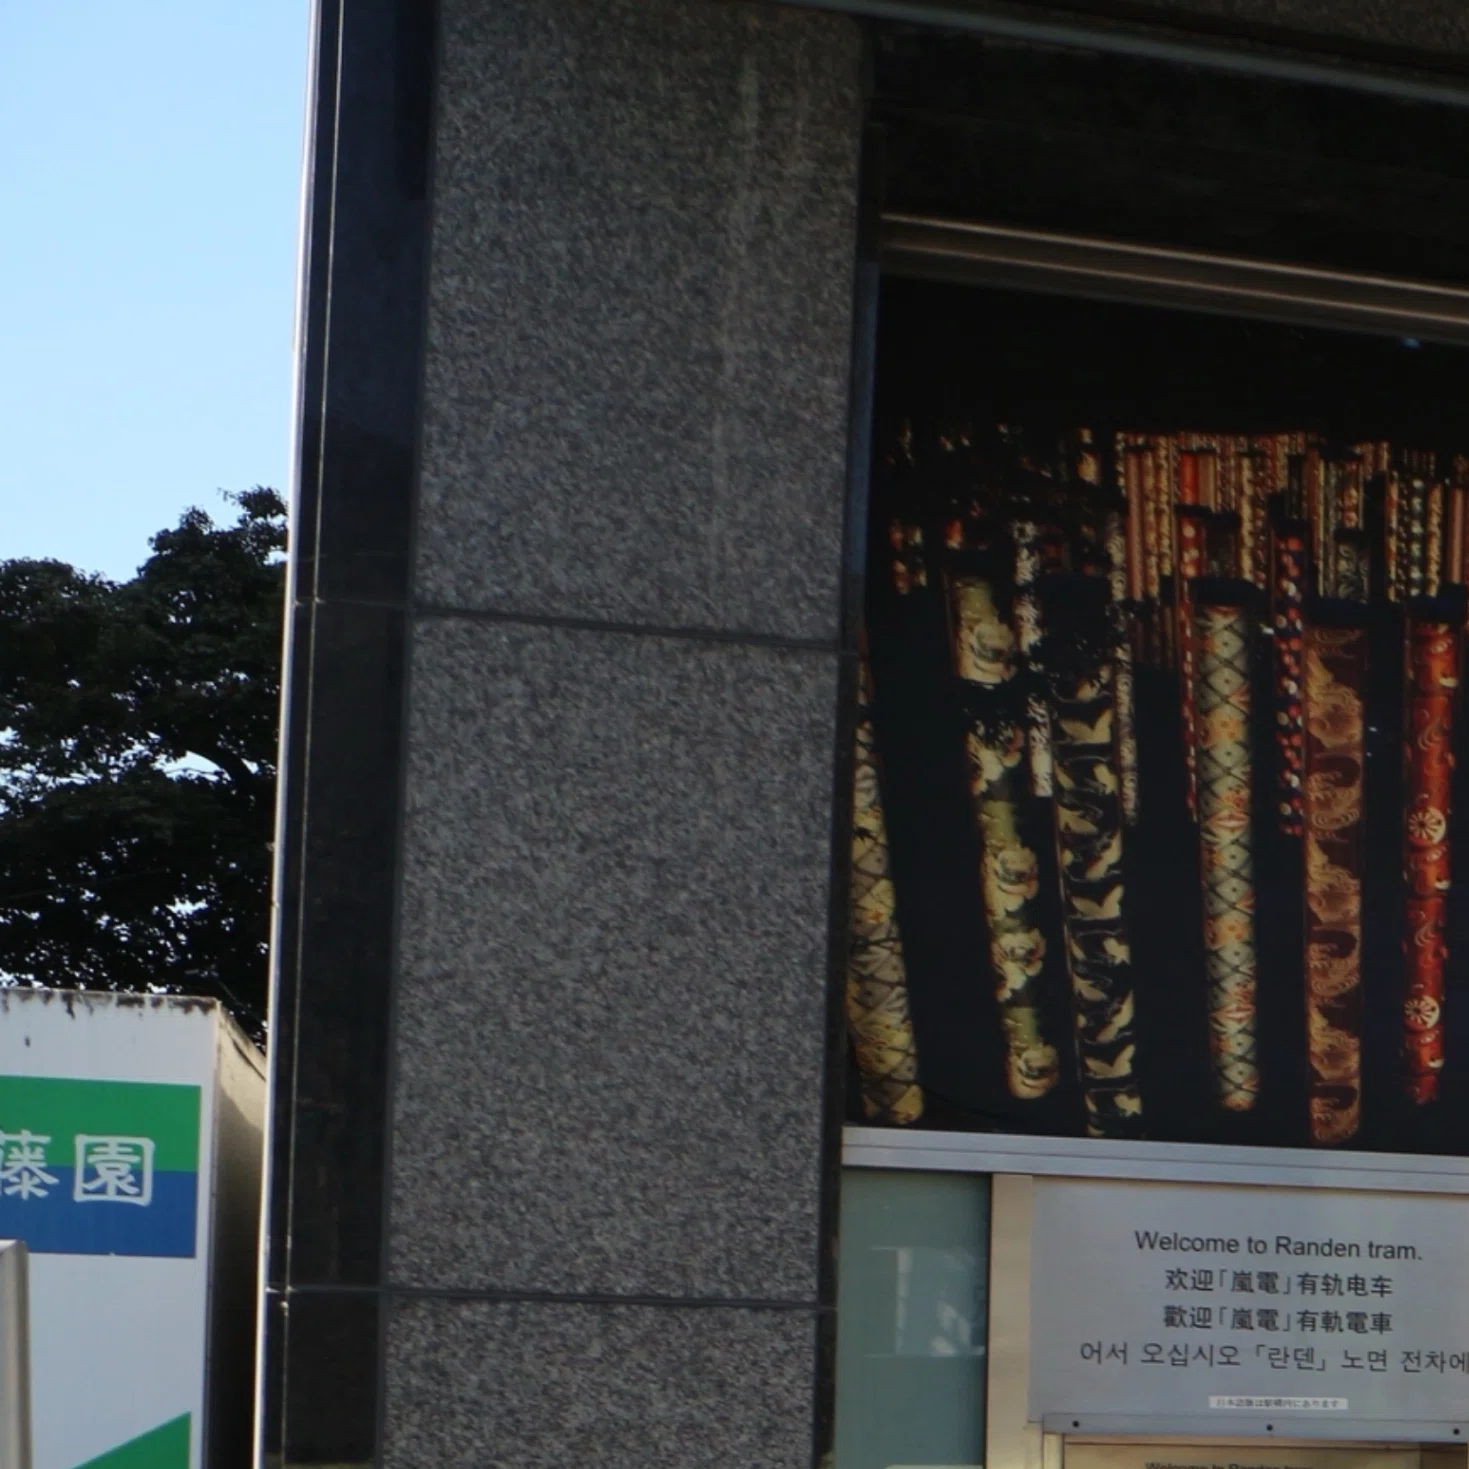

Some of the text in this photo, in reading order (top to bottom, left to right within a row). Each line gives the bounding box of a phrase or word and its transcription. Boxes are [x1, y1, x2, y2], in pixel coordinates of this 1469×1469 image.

[1135, 1231, 1422, 1261] Welcome to Randen tram.
[1080, 1342, 1128, 1367] 어서
[1141, 1343, 1241, 1368] 오십시오
[1341, 1348, 1389, 1373] 노면
